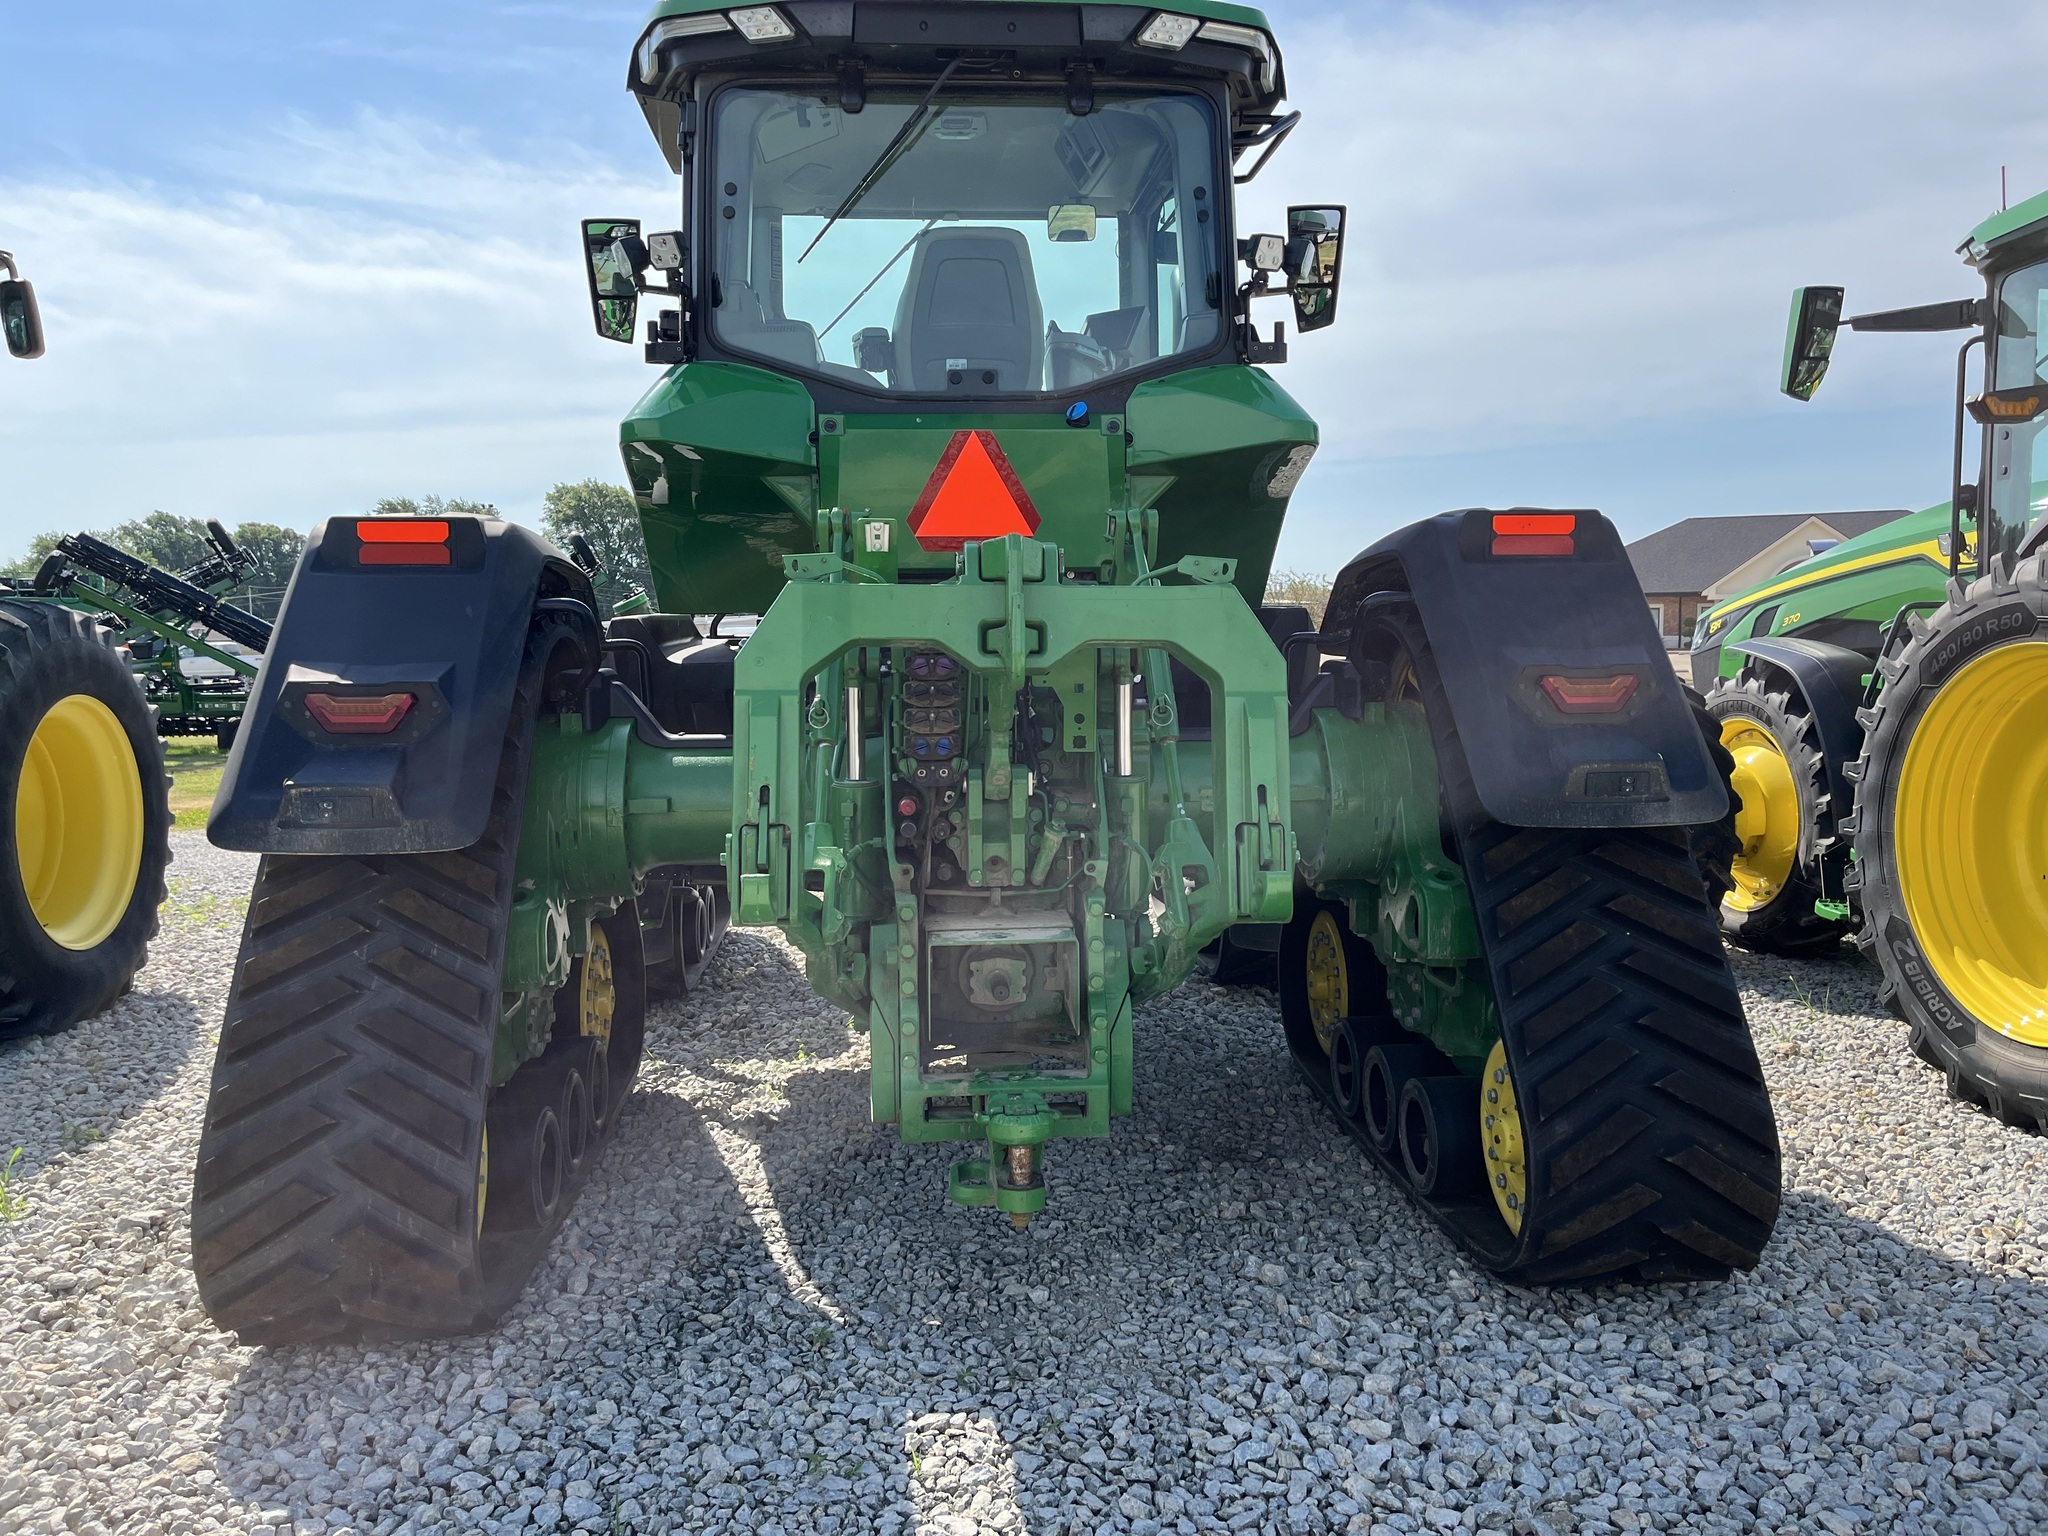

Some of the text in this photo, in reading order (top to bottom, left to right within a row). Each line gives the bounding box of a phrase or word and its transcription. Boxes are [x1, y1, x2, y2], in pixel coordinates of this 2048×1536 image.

[1709, 619, 1722, 634] 8R
[1782, 613, 1801, 627] 370
[1931, 612, 2023, 675] 480/80 R50
[1892, 937, 1963, 1031] AGRIBIB 2
